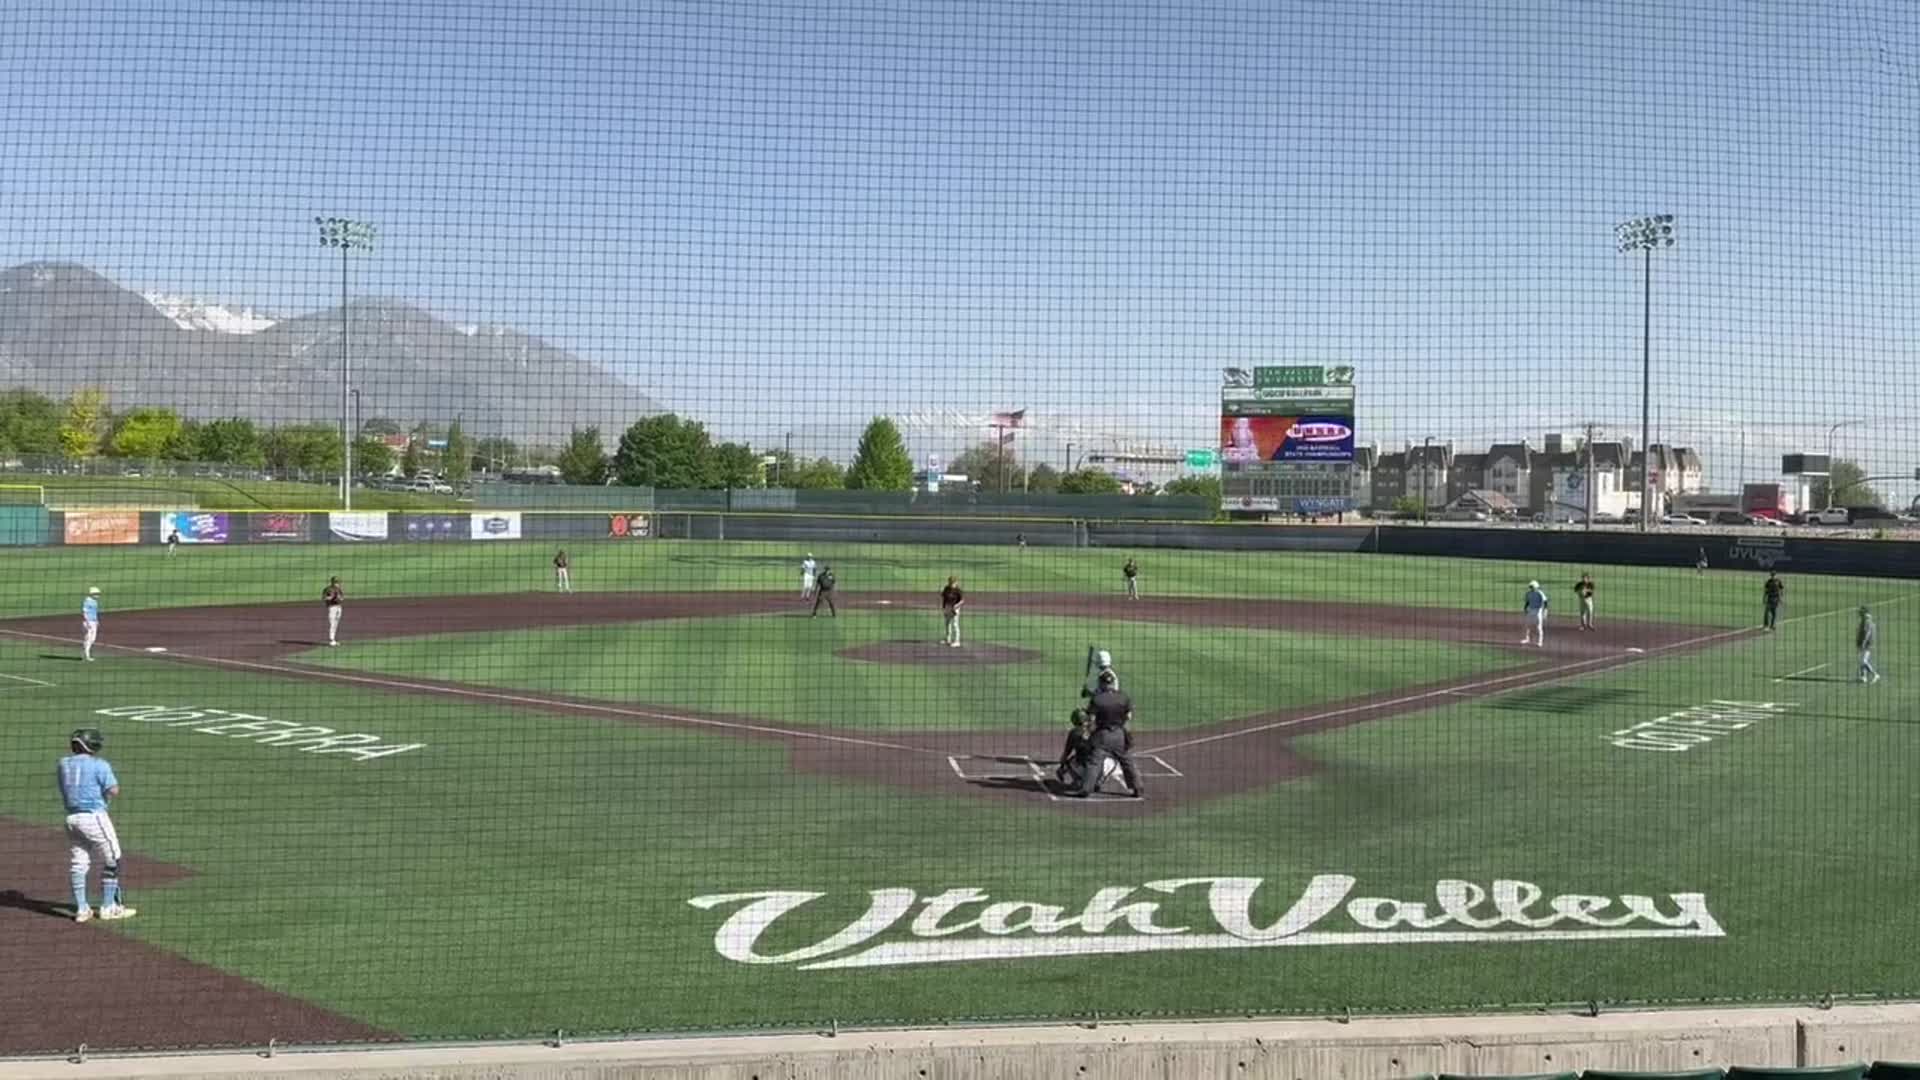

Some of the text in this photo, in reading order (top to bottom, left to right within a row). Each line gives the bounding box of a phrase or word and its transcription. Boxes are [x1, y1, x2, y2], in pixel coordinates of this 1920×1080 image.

[1257, 375, 1320, 383] UNIVERSITY
[688, 874, 1726, 968] Utah Valley
